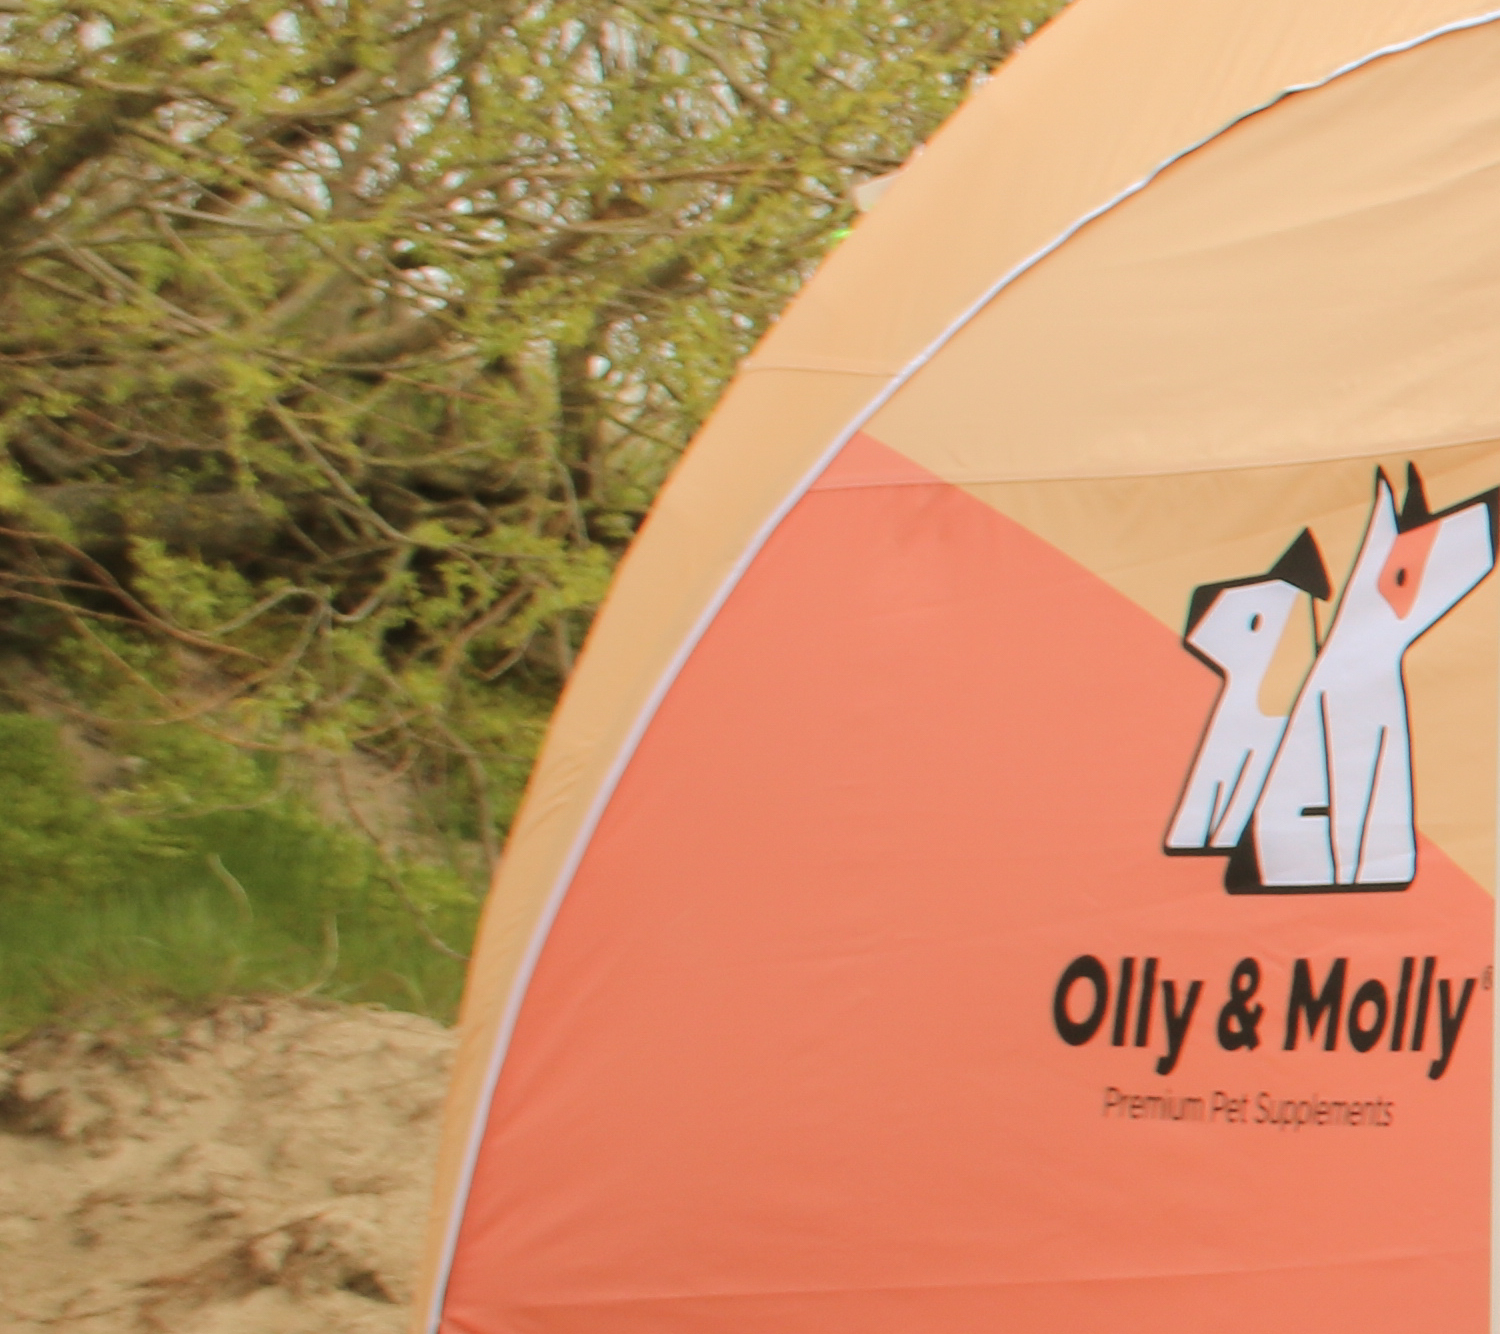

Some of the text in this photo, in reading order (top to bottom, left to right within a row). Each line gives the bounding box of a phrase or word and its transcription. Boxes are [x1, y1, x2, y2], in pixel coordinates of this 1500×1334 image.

[1053, 954, 1204, 1076] Olly
[1217, 956, 1264, 1051] &
[1103, 1086, 1394, 1132] Premium Pet Supplements
